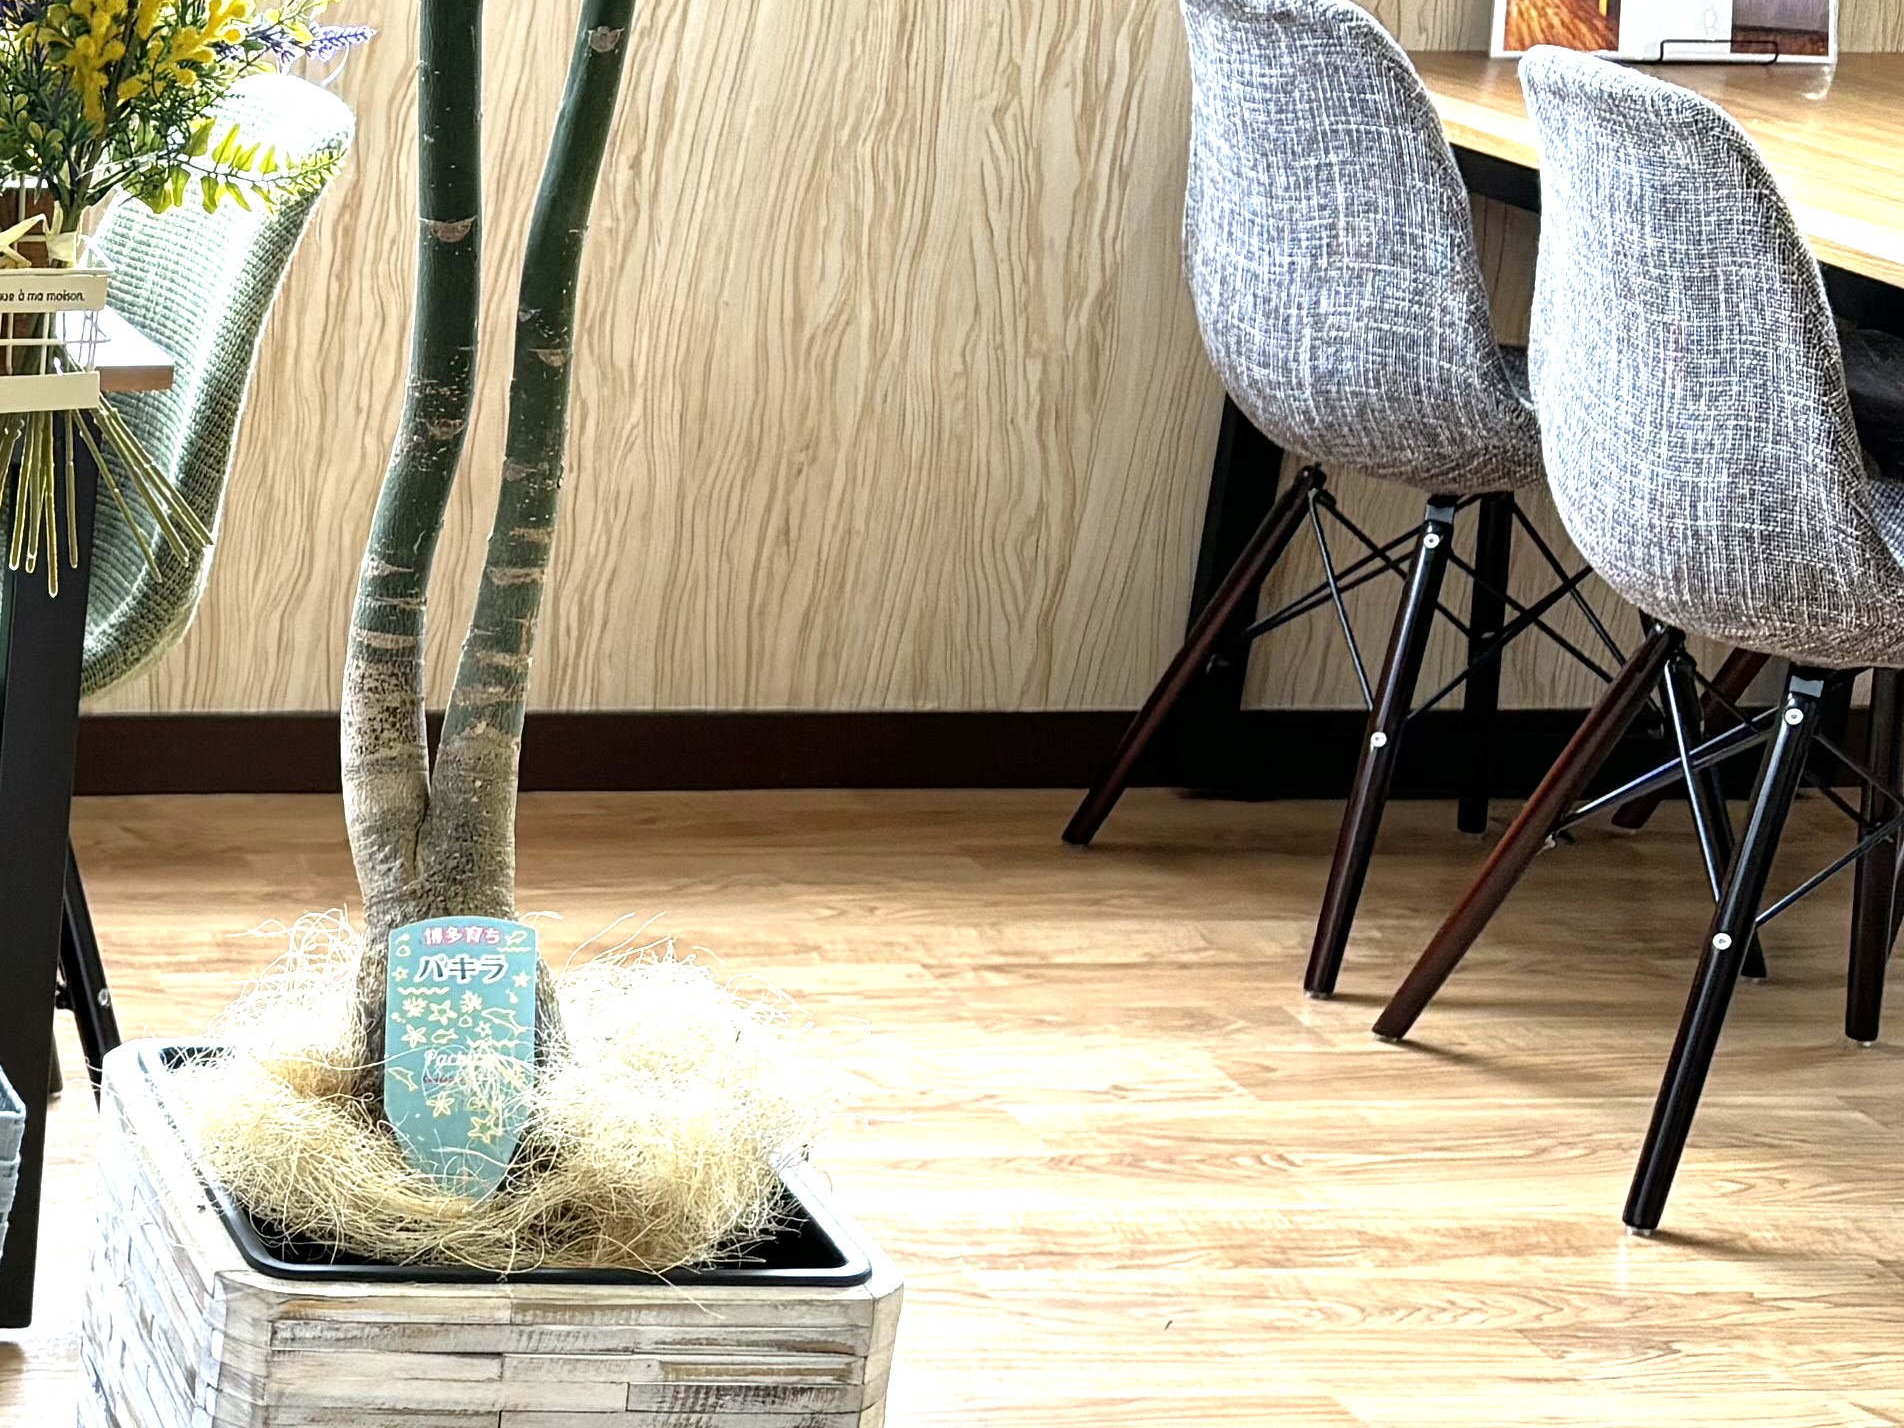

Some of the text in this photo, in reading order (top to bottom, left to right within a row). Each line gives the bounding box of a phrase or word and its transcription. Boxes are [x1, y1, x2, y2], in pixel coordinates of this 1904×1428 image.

[27, 292, 44, 302] ma
[424, 926, 501, 946] 博多育ち
[414, 953, 508, 984] パキラ
